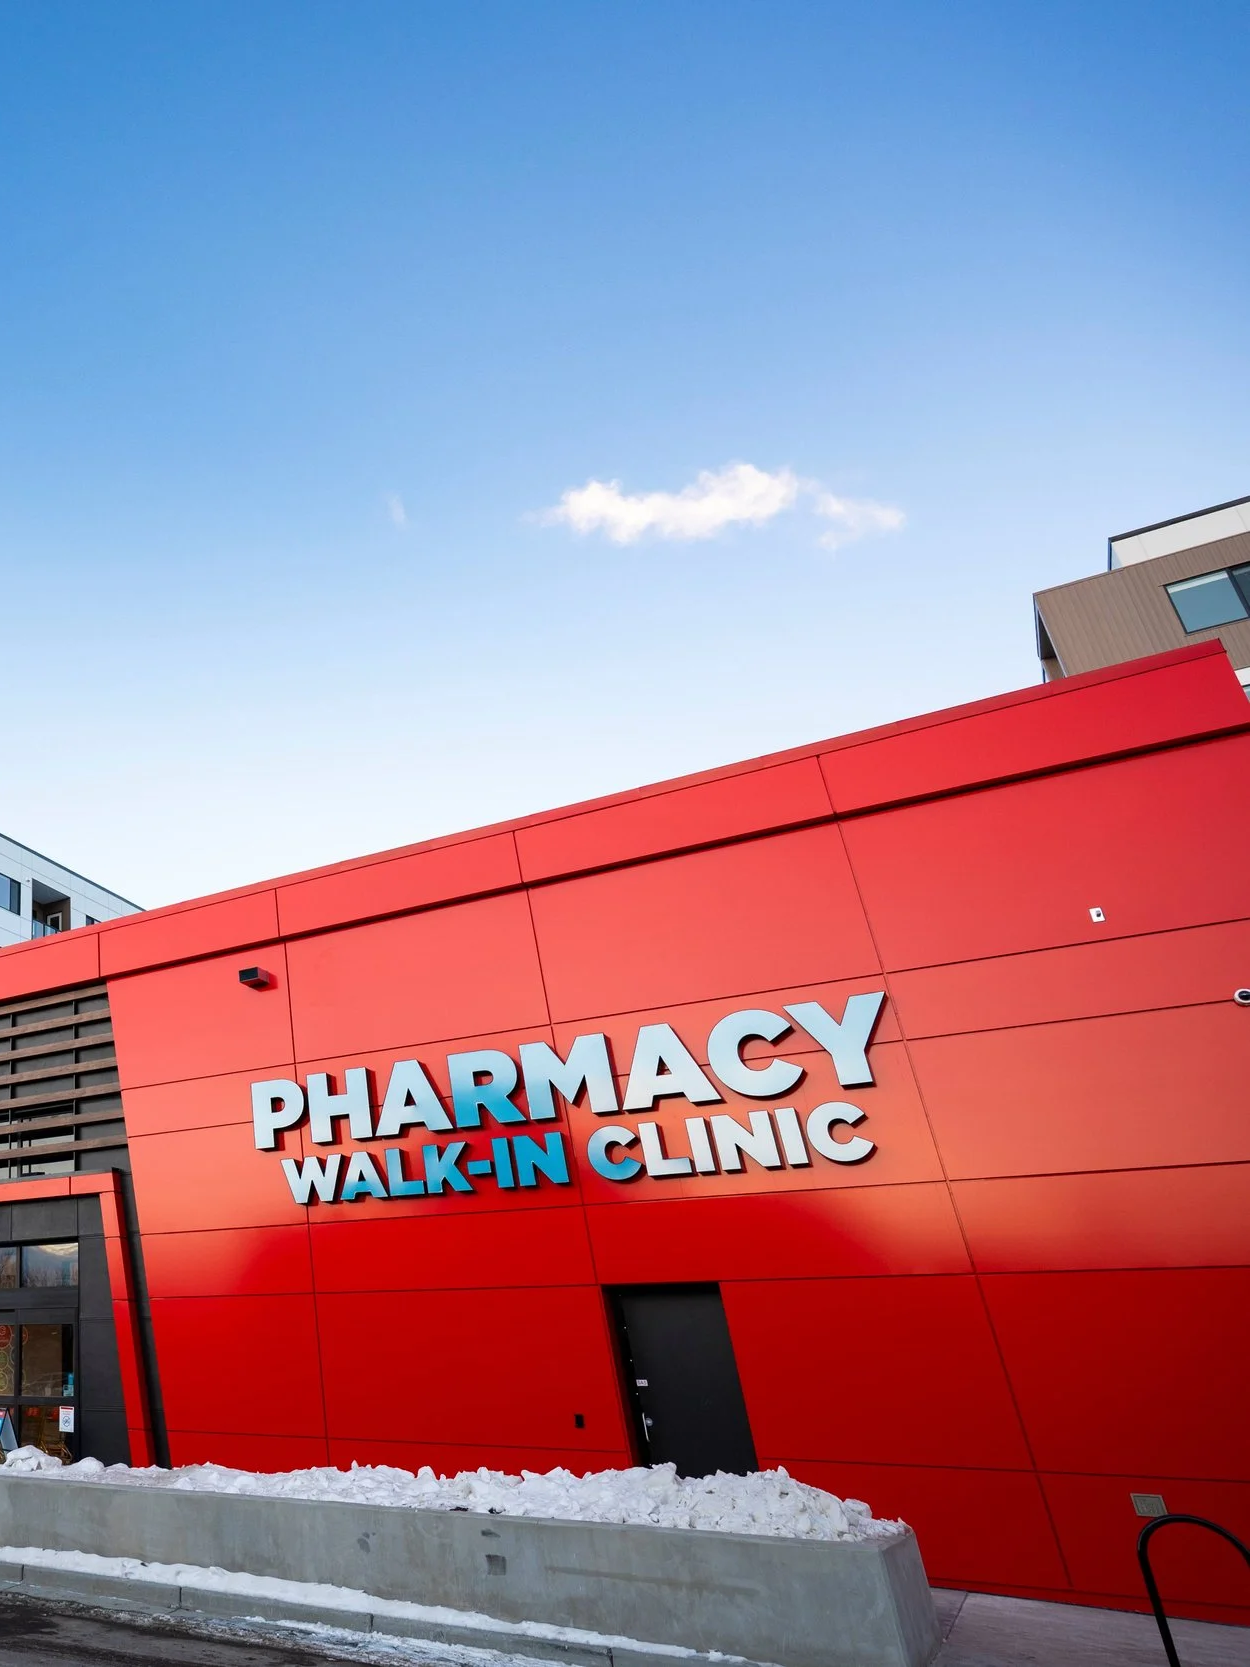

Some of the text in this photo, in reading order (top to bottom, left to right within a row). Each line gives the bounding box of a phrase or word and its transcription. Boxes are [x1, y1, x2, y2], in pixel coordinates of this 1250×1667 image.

[250, 990, 886, 1151] PHARMACY
[280, 1101, 877, 1205] WALK-IN CLINIC
